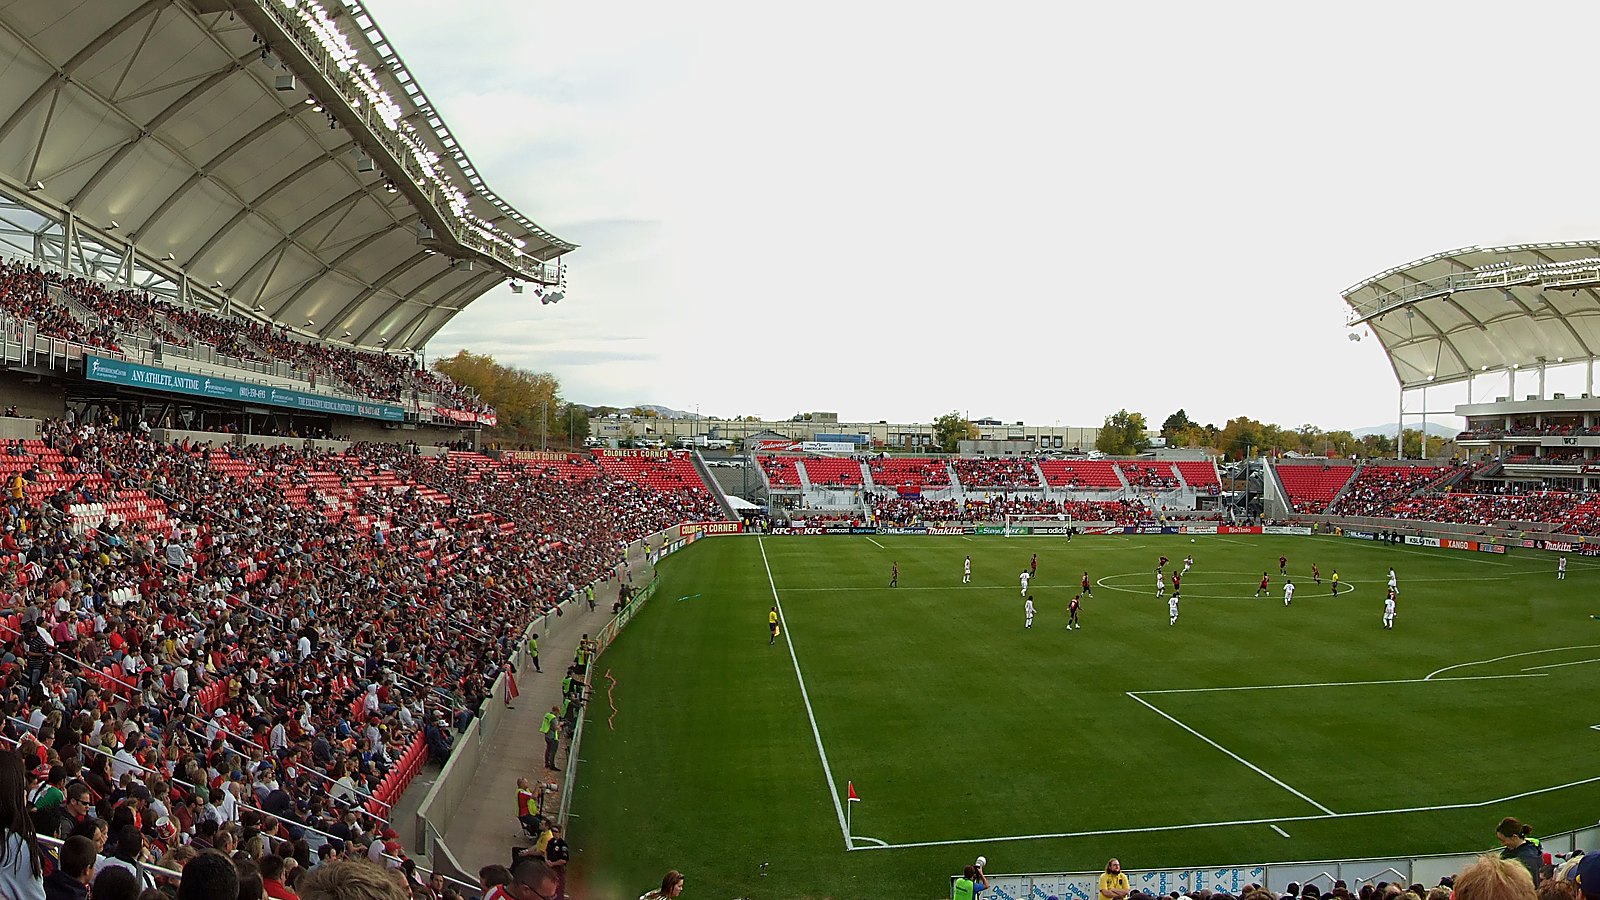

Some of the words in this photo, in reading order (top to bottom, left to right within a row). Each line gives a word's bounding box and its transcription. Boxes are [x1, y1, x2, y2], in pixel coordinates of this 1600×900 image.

[131, 370, 145, 381] ANY
[145, 372, 173, 388] ATHLETE,
[755, 441, 792, 450] Budweiser
[1563, 437, 1578, 445] WCF
[514, 452, 540, 460] COLONEL'S
[542, 452, 567, 461] CORNER
[709, 523, 738, 533] CORNER
[771, 527, 790, 535] KFC
[803, 527, 823, 535] KFC
[927, 527, 964, 535] Makita
[1447, 540, 1469, 549] XANGO
[1544, 540, 1573, 552] Makita
